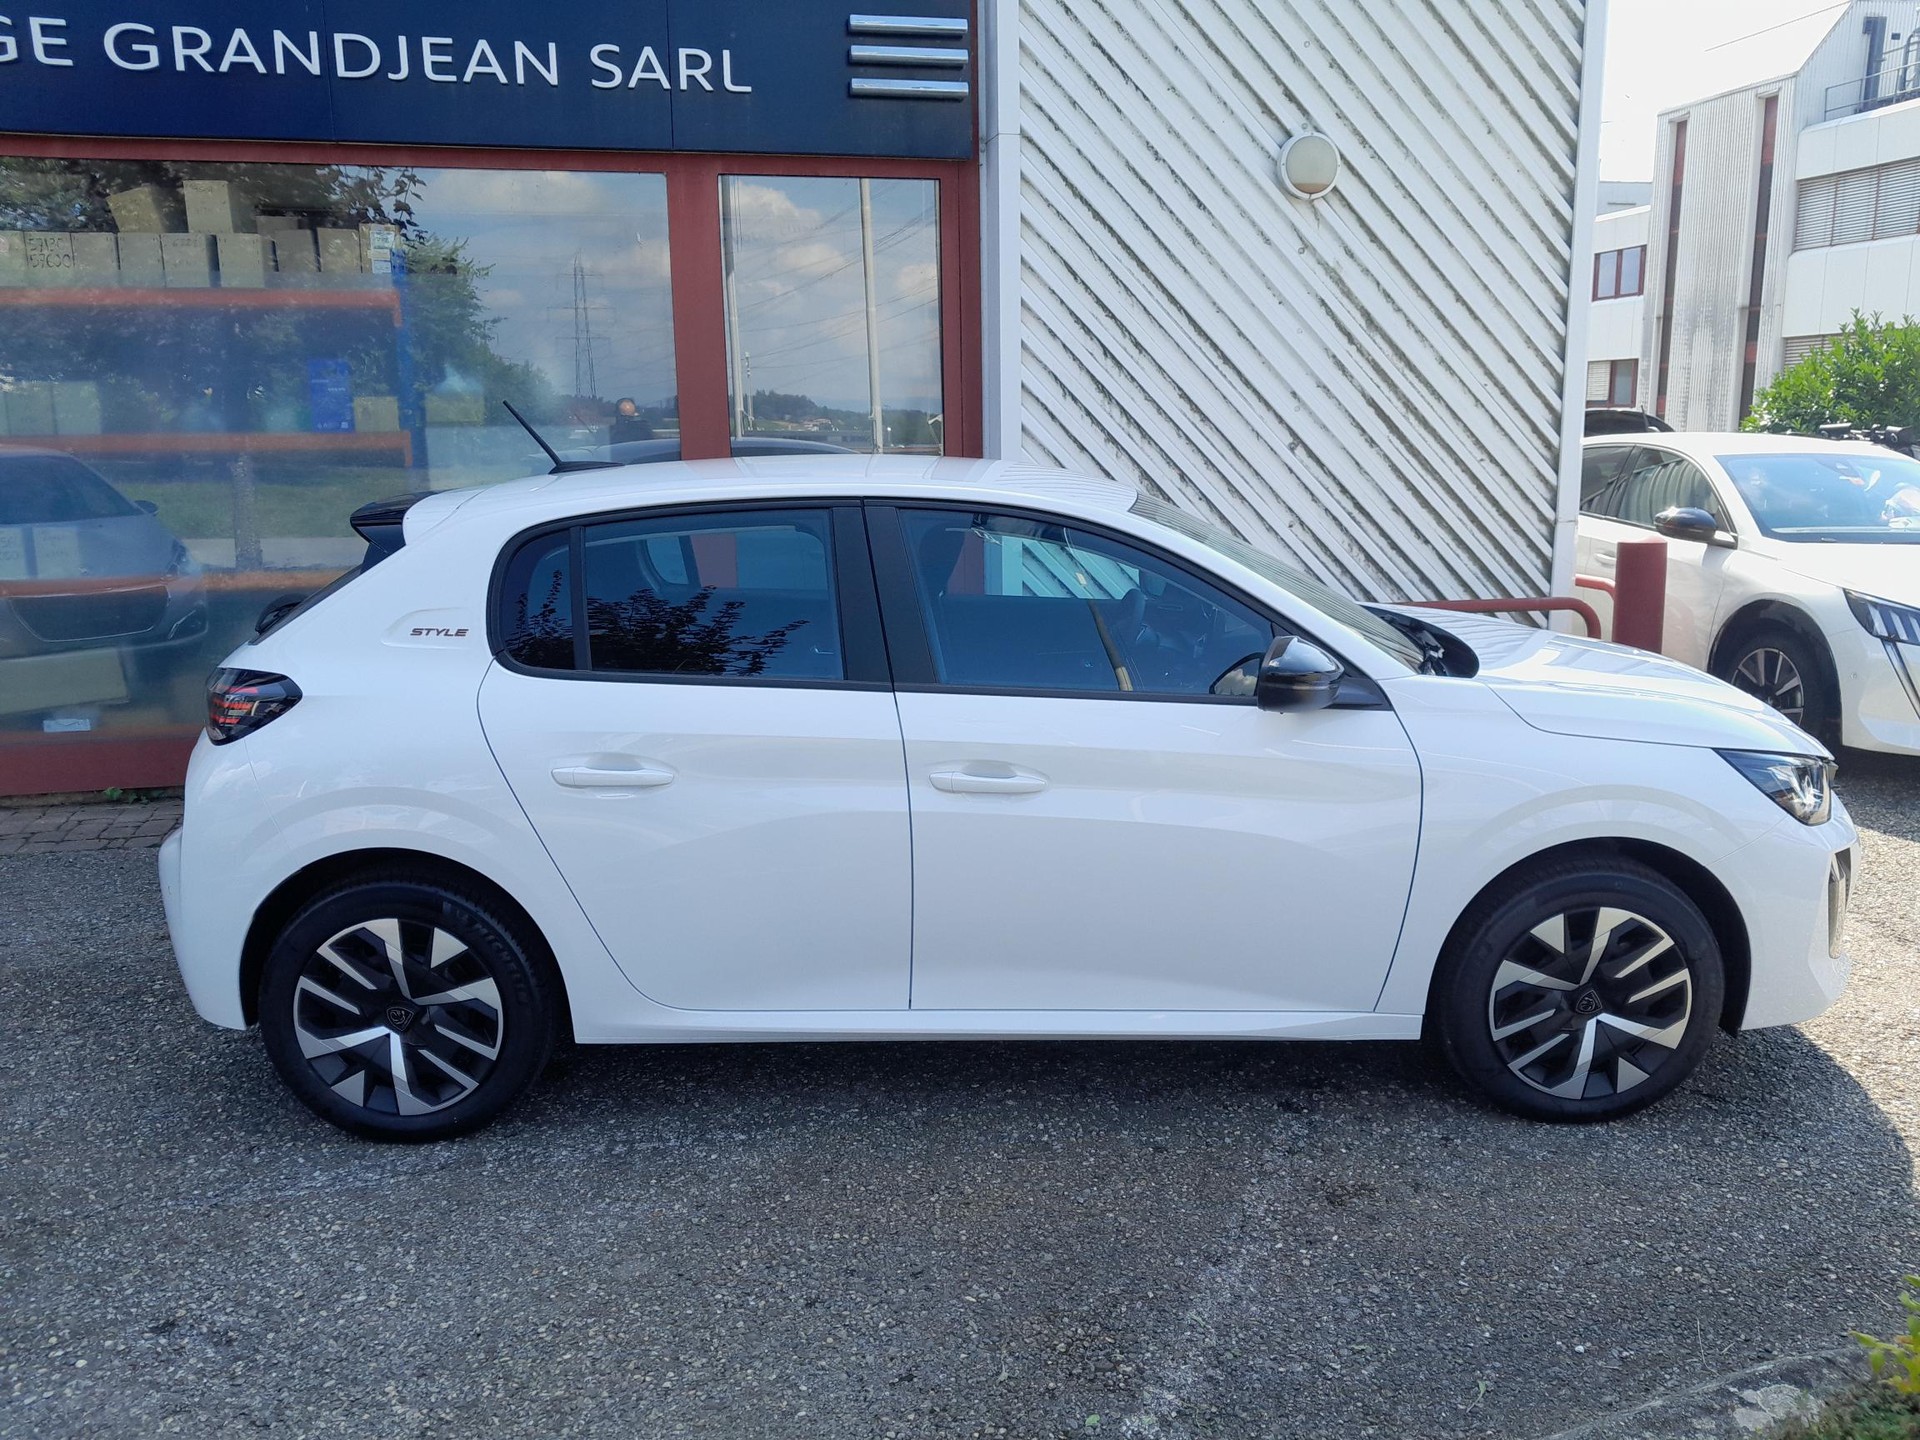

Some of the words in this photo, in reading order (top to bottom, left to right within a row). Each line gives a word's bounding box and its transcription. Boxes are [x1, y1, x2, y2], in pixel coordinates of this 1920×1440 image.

[103, 22, 559, 87] GRANDJEAN
[590, 43, 752, 93] SARL
[410, 628, 469, 637] STYLE
